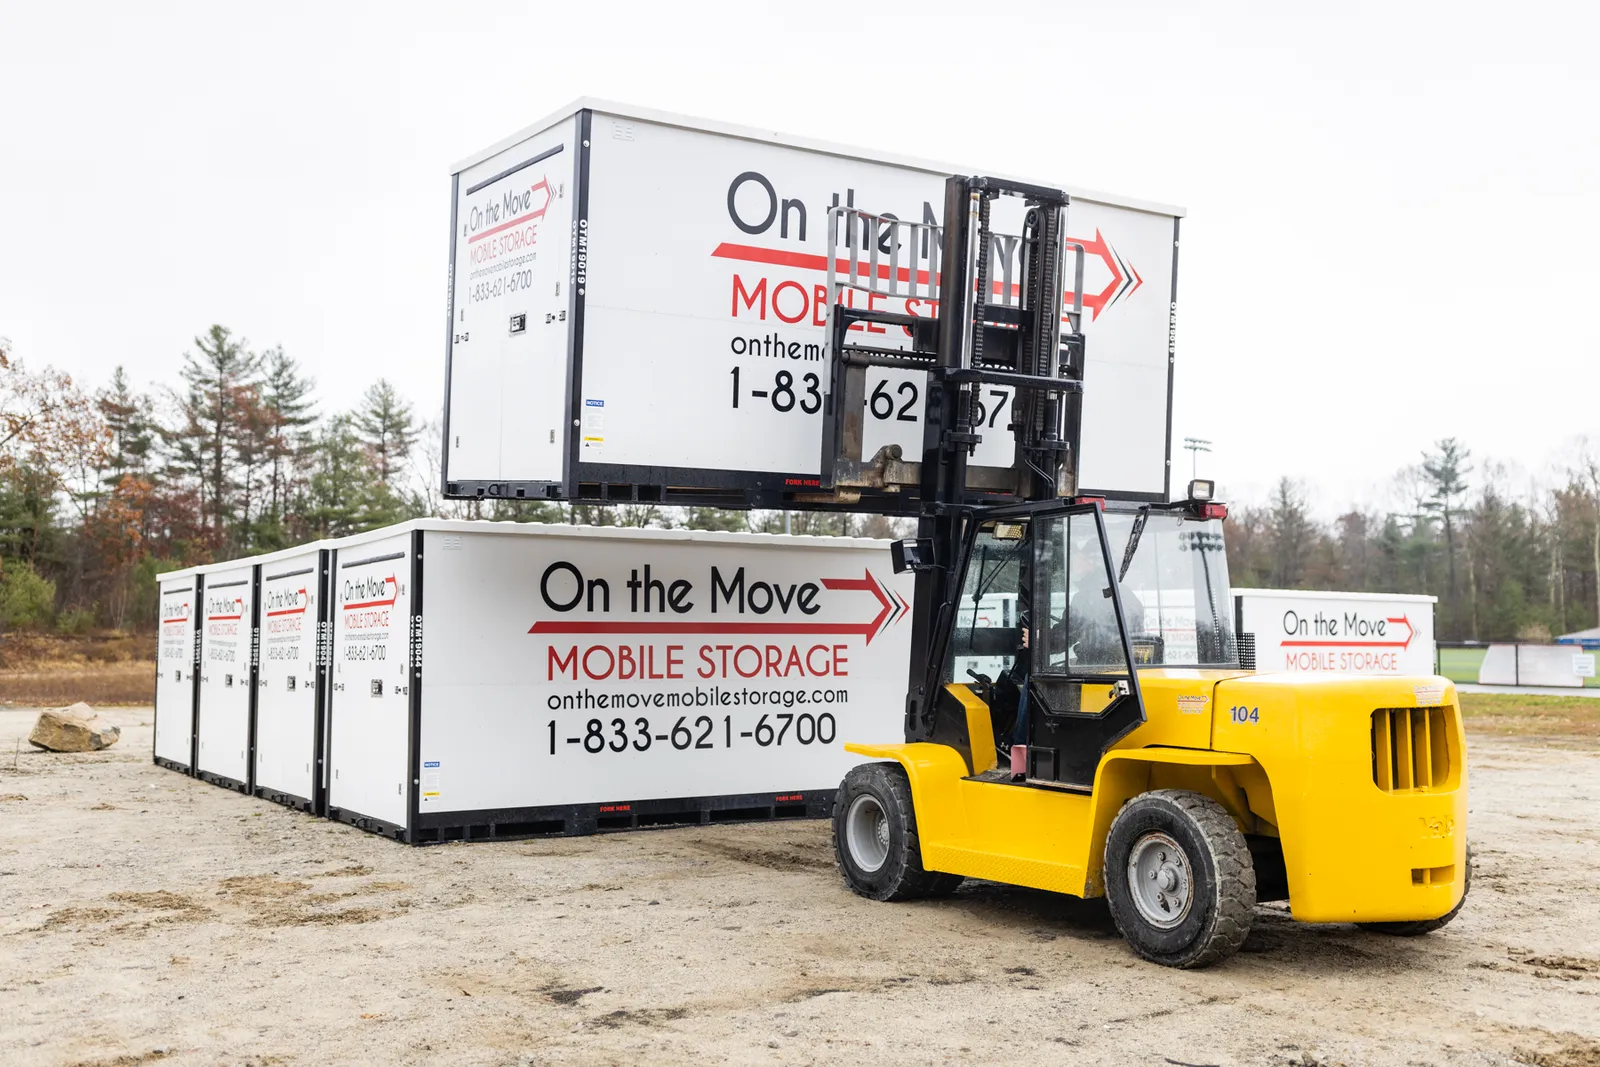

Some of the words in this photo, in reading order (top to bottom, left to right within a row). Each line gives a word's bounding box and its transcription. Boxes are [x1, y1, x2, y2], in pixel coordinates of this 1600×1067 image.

[470, 206, 483, 231] On
[486, 199, 500, 226] the
[503, 189, 531, 219] Move
[727, 171, 807, 241] On
[470, 239, 497, 266] MOBILE
[499, 224, 537, 256] STORAGE
[577, 219, 588, 284] OTM19019
[468, 269, 532, 304] 1-833-621-6700
[785, 478, 802, 486] FORK
[803, 479, 820, 487] HERE
[345, 579, 354, 600] On
[355, 577, 365, 599] the
[367, 576, 385, 598] Move
[540, 561, 610, 612] On
[626, 564, 694, 614] the
[711, 566, 821, 615] Move
[344, 613, 363, 630] MOBILE
[364, 610, 389, 629] STORAGE
[1283, 610, 1308, 635] On
[1314, 611, 1338, 636] the
[1344, 612, 1386, 636] Move
[548, 645, 684, 681] MOBILE
[697, 644, 848, 679] STORAGE
[1286, 652, 1335, 671] MOBILE
[1340, 652, 1397, 671] STORAGE
[547, 687, 848, 710] onthemovemobilestorage.com
[1230, 706, 1259, 722] 104
[547, 712, 837, 755] 1-833-621-6700
[600, 805, 615, 813] FORK
